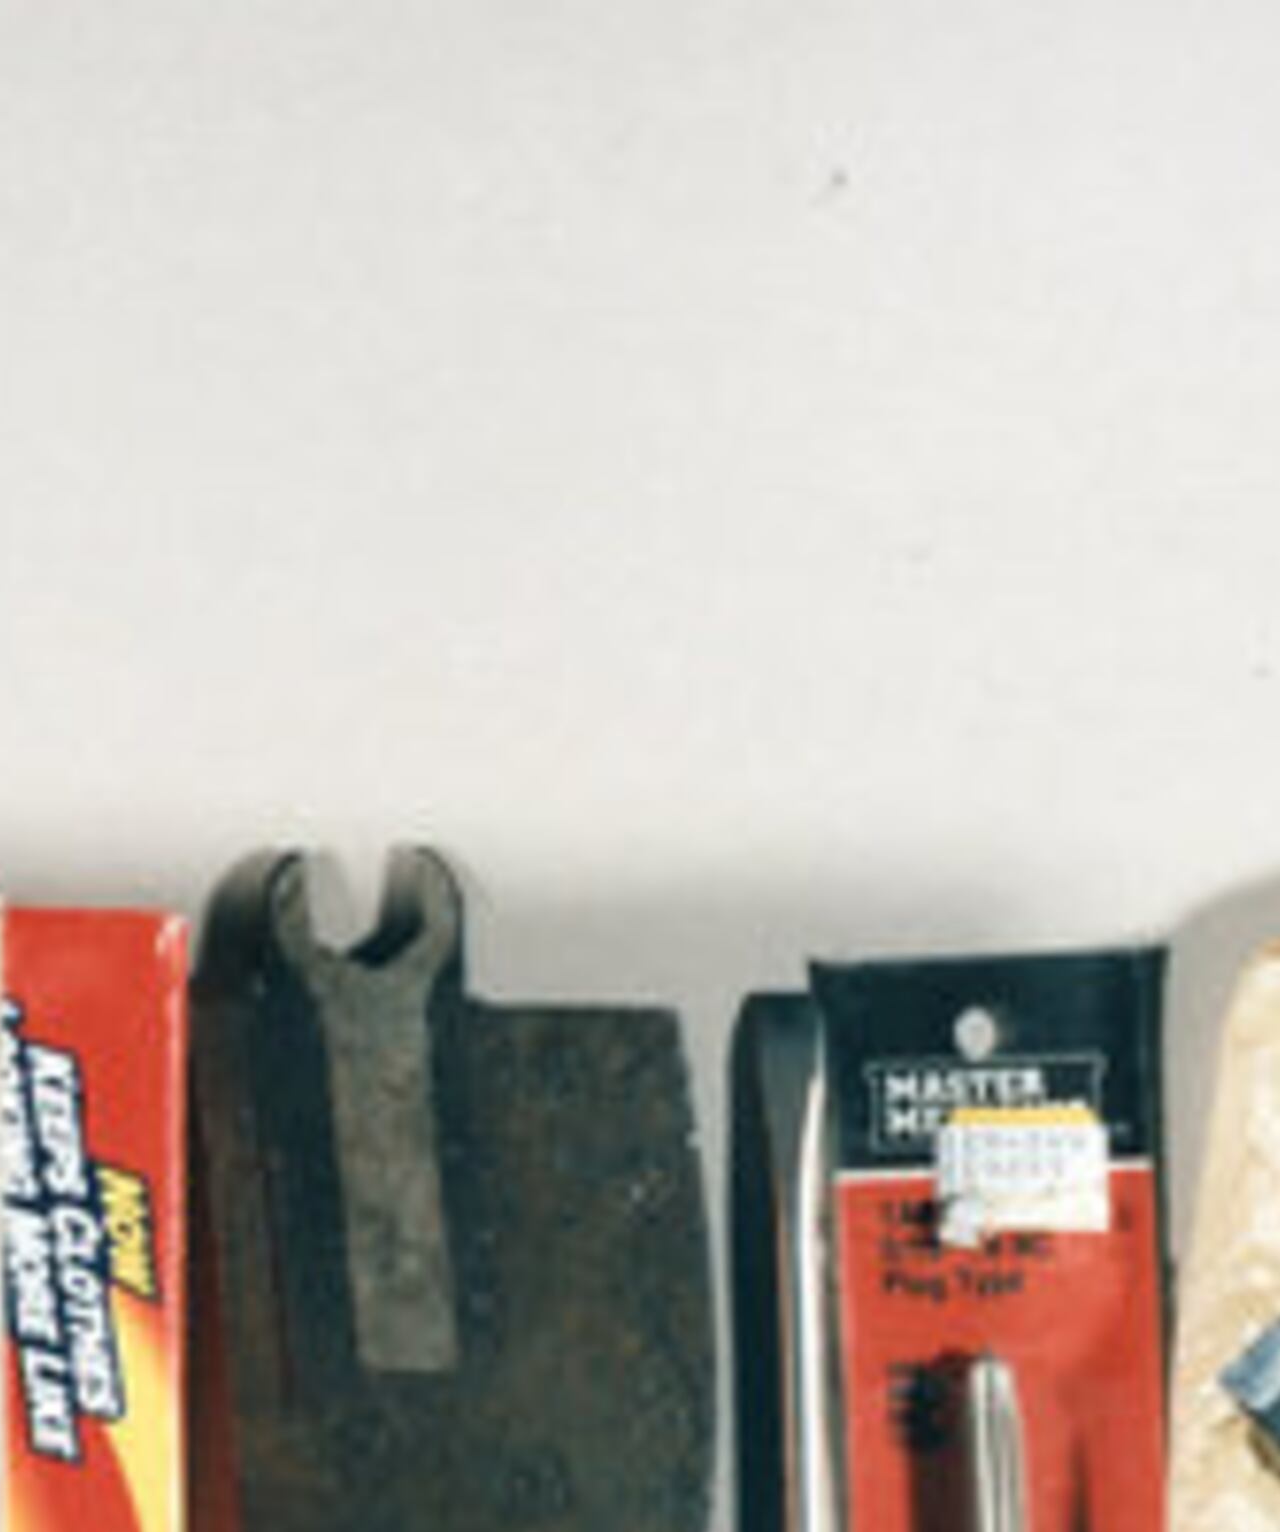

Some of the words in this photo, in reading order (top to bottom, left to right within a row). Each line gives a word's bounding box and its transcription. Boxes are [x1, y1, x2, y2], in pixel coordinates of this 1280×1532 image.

[22, 1046, 89, 1197] KEEPS
[883, 1066, 1048, 1102] MASTER
[5, 1202, 61, 1342] MORE
[94, 1163, 158, 1297] NOW
[47, 1203, 124, 1418] CLOTHES
[22, 1346, 80, 1460] LIKE
